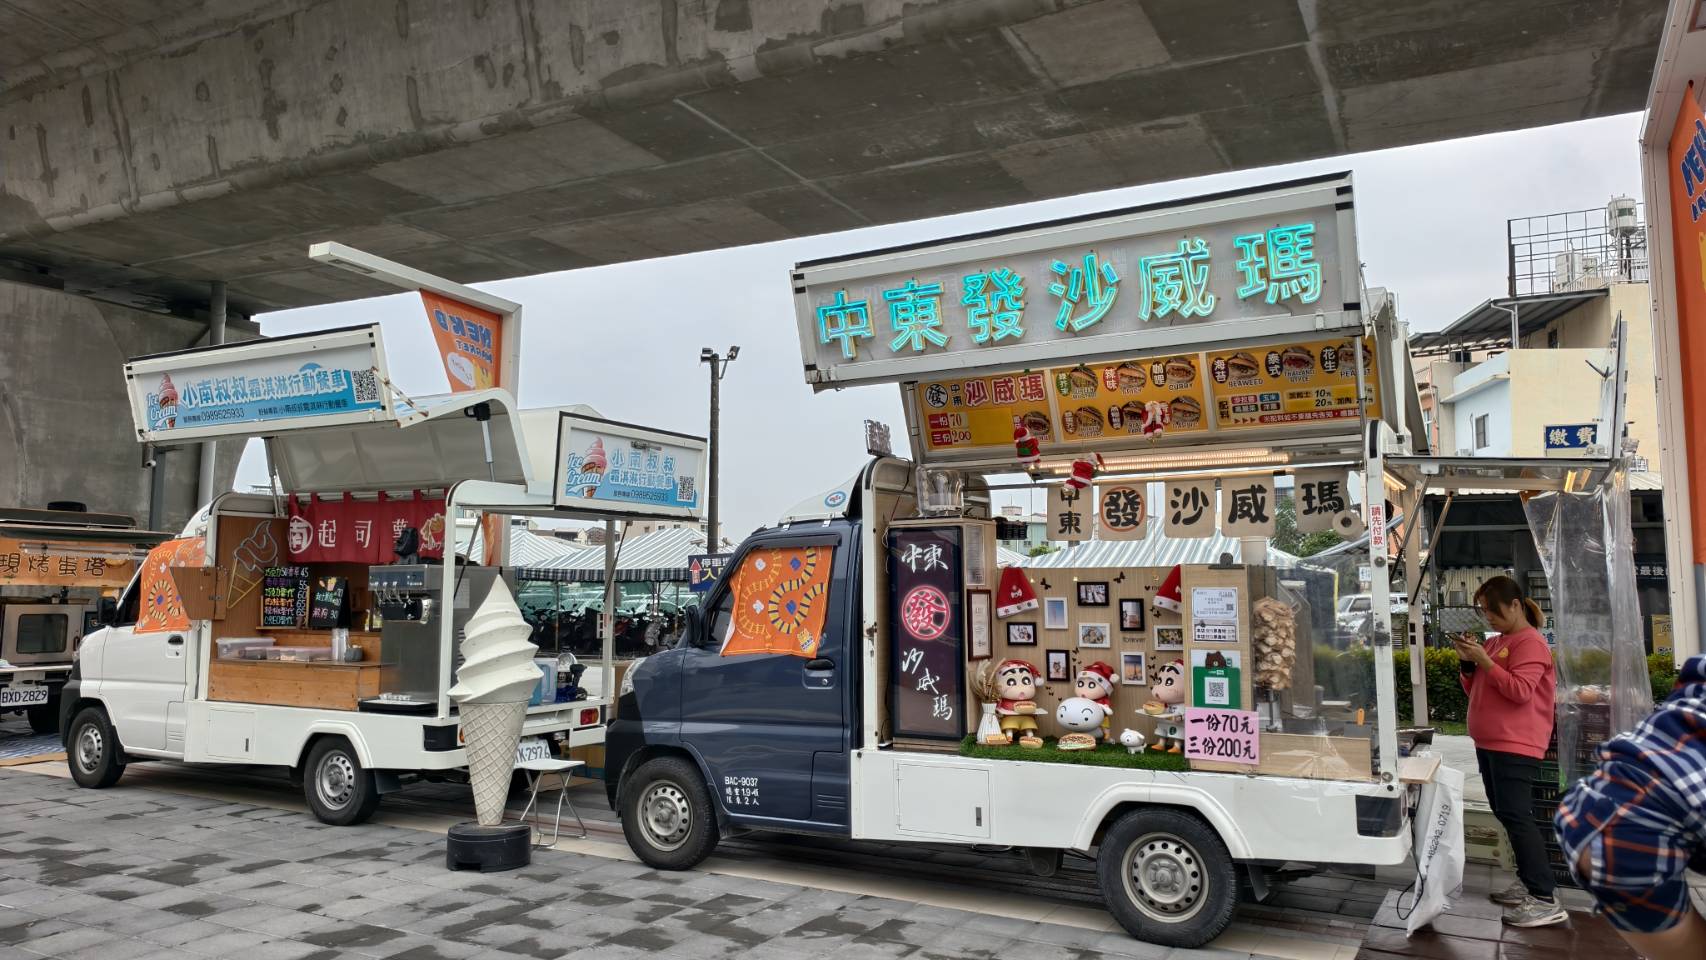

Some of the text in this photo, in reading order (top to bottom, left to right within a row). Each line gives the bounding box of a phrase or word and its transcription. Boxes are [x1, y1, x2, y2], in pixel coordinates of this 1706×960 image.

[816, 222, 1322, 361] 中東發沙威瑪
[1214, 359, 1227, 382] 海苔
[1268, 353, 1280, 377] 泰式
[1323, 348, 1336, 372] 花生
[182, 368, 348, 407] 小南叔叔霜淇淋行動餐車
[965, 374, 1045, 406] 沙威瑪
[1228, 379, 1264, 388] SEAWEED
[149, 405, 177, 421] Cream
[1549, 424, 1597, 447] 繳費
[568, 452, 583, 468] Ice
[611, 450, 675, 473] 小南叔叔
[567, 469, 601, 485] Cream
[1371, 506, 1384, 546] 請先付款
[0, 553, 106, 577] 現烤蛋塔
[902, 648, 953, 720] 沙威瑪
[2, 690, 48, 704] BXD-2829
[1190, 714, 1254, 734] 一份70元
[1188, 736, 1256, 760] 三份200元
[725, 776, 759, 787] BAC-9037
